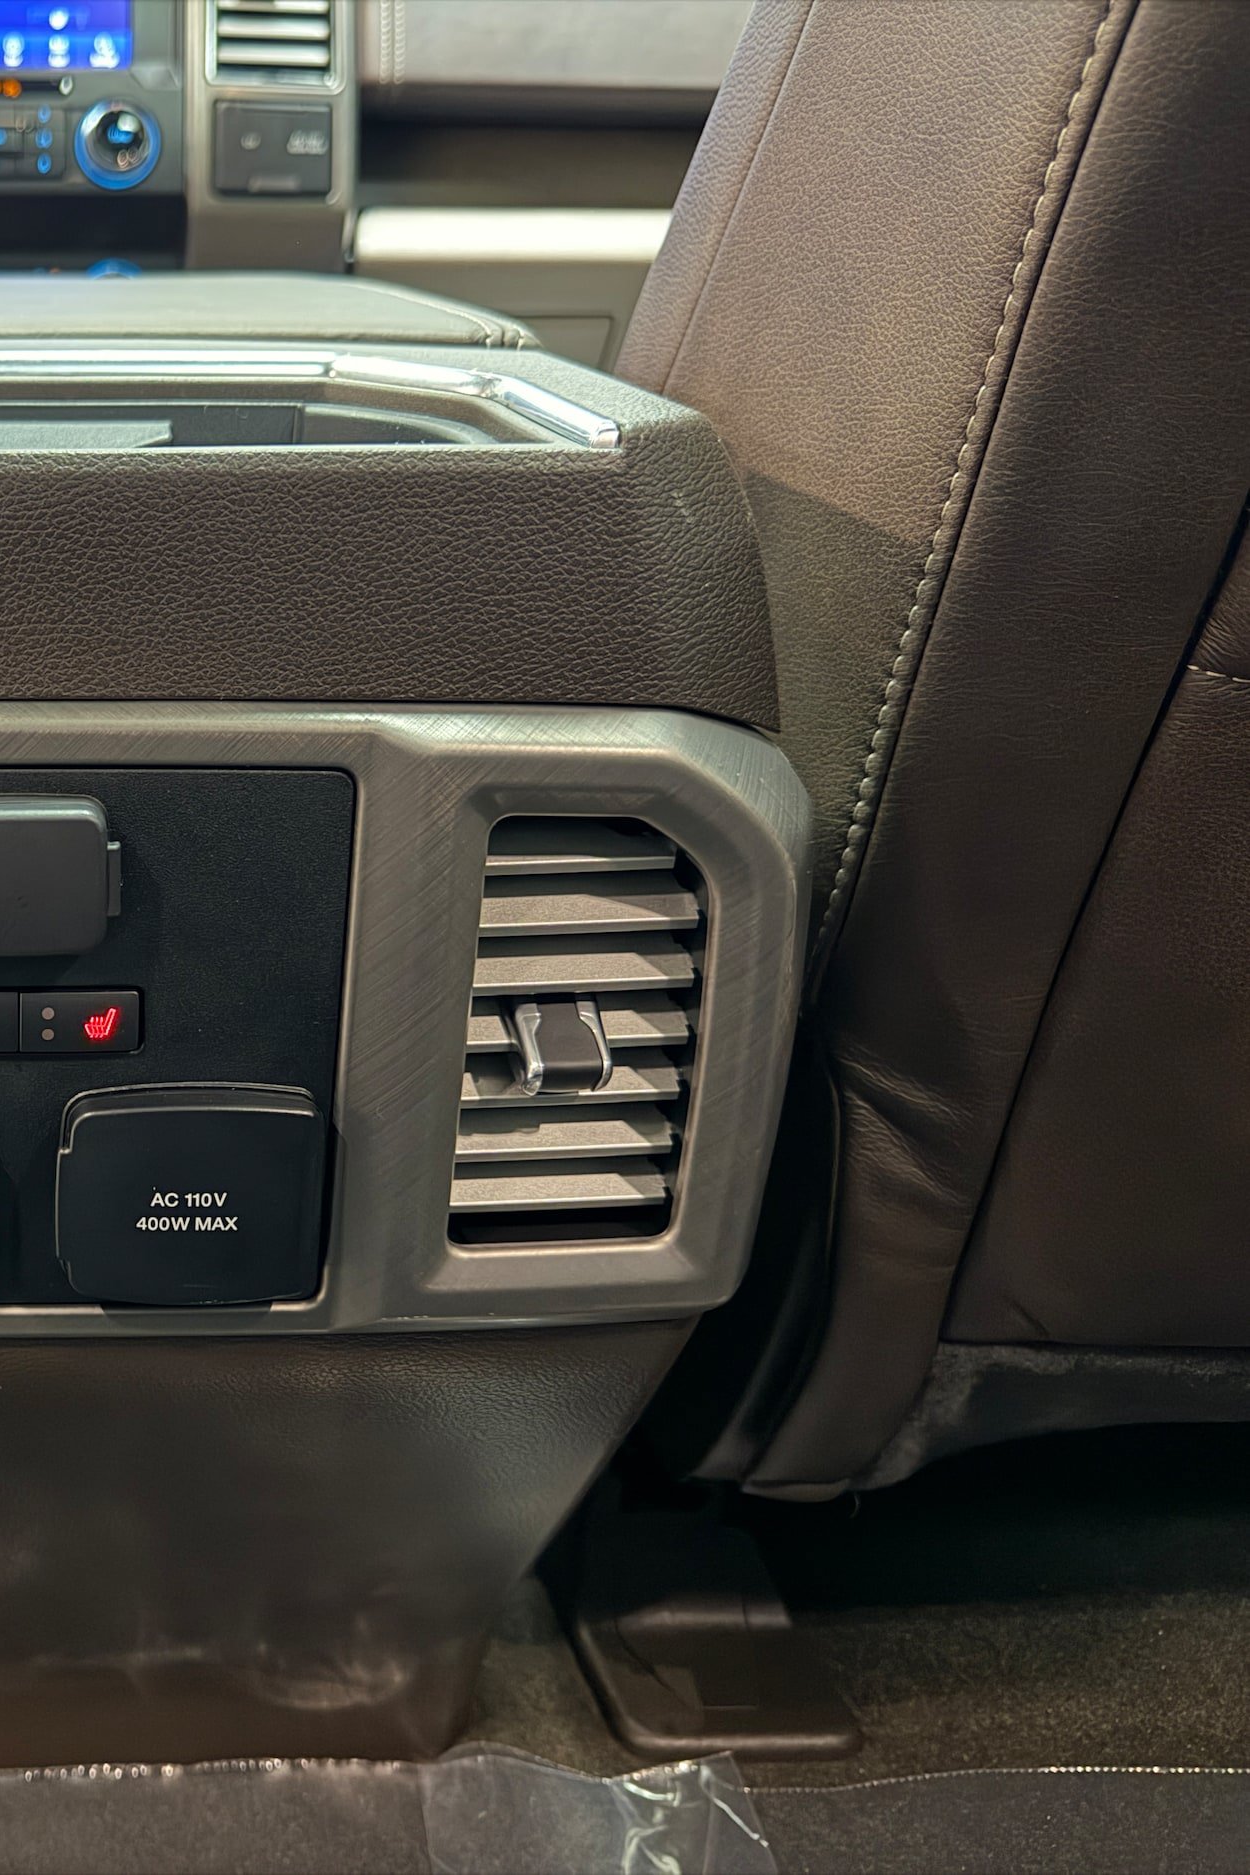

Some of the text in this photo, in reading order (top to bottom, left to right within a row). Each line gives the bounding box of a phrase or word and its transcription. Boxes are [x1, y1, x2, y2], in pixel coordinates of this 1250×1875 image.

[150, 1192, 228, 1208] AC 110V
[135, 1216, 239, 1232] 400W MAX
